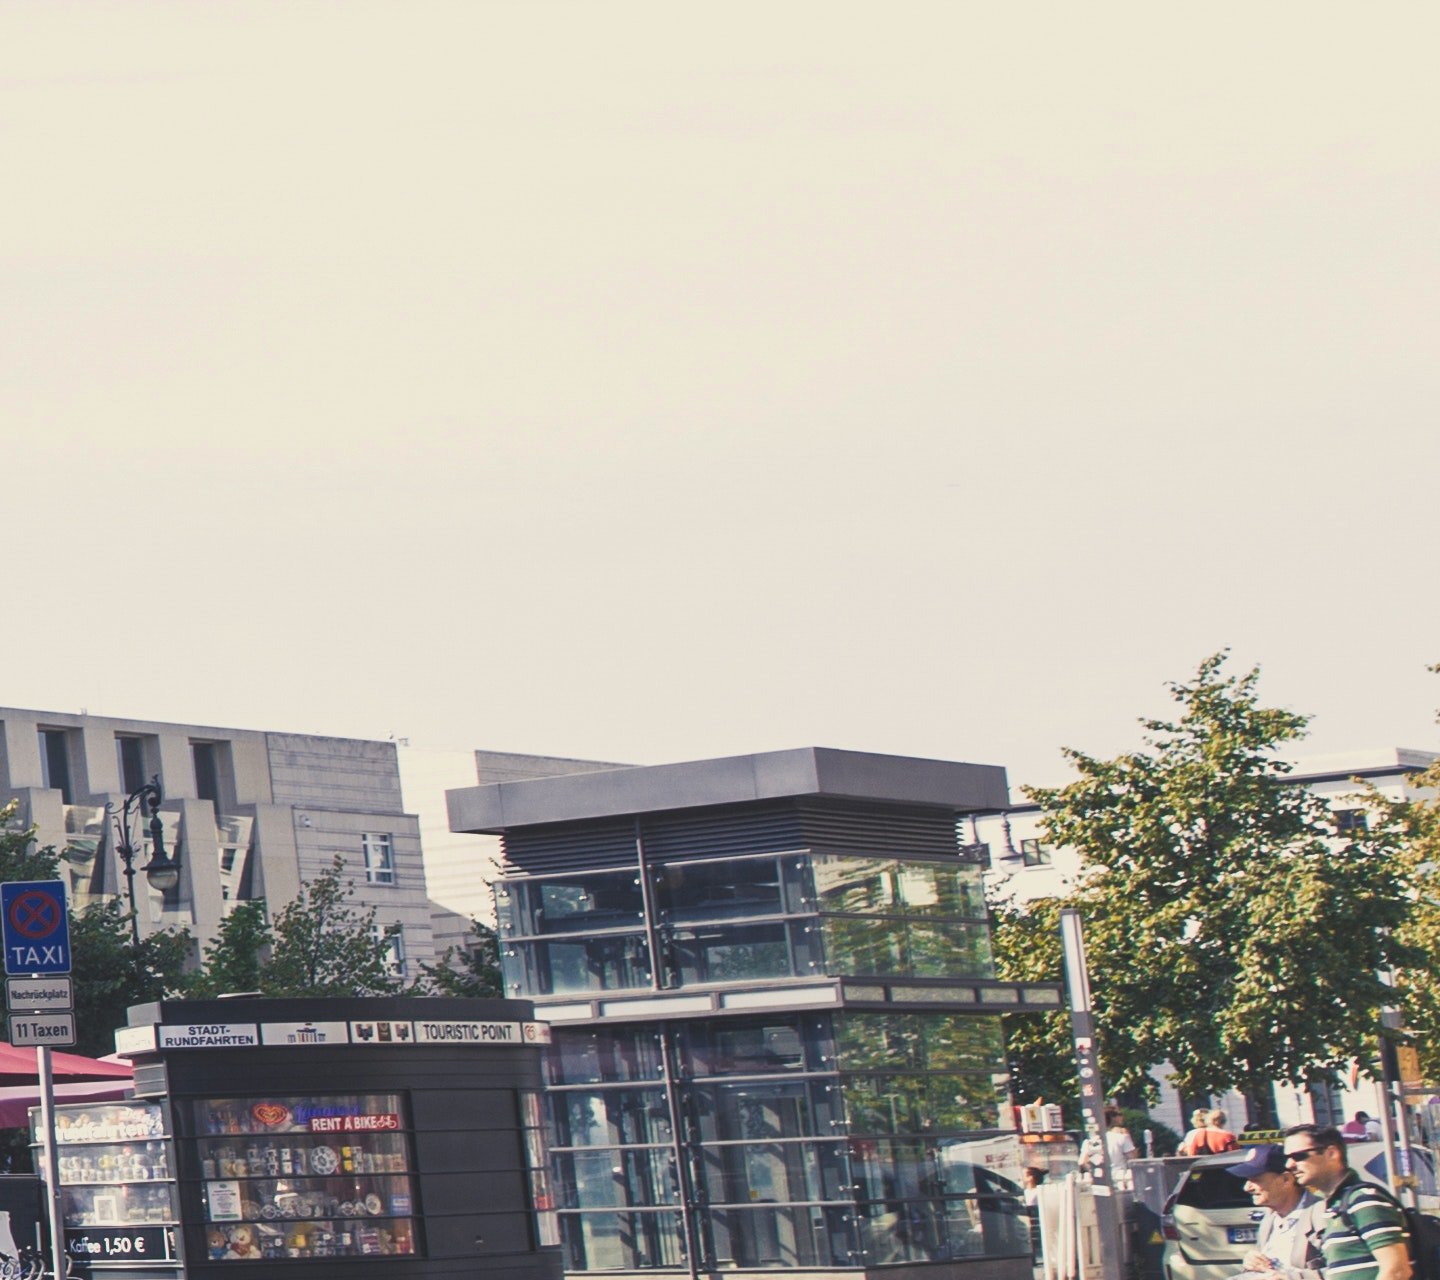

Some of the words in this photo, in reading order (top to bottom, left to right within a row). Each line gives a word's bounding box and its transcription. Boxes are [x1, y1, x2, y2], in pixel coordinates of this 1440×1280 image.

[11, 945, 64, 965] TAXI
[10, 989, 69, 1001] Nachrückplatz
[15, 1023, 28, 1038] 11
[30, 1023, 68, 1038] Taxen
[188, 1025, 231, 1036] STADT-
[423, 1023, 479, 1041] TOURISTIC
[482, 1024, 512, 1041] POINT
[165, 1035, 254, 1047] RUNDFAHRTEN
[312, 1117, 342, 1131] RENT
[344, 1116, 353, 1130] A
[354, 1115, 376, 1129] BIKE
[70, 1236, 102, 1253] Kaffee
[104, 1237, 131, 1255] 1,50
[134, 1236, 146, 1253] €
